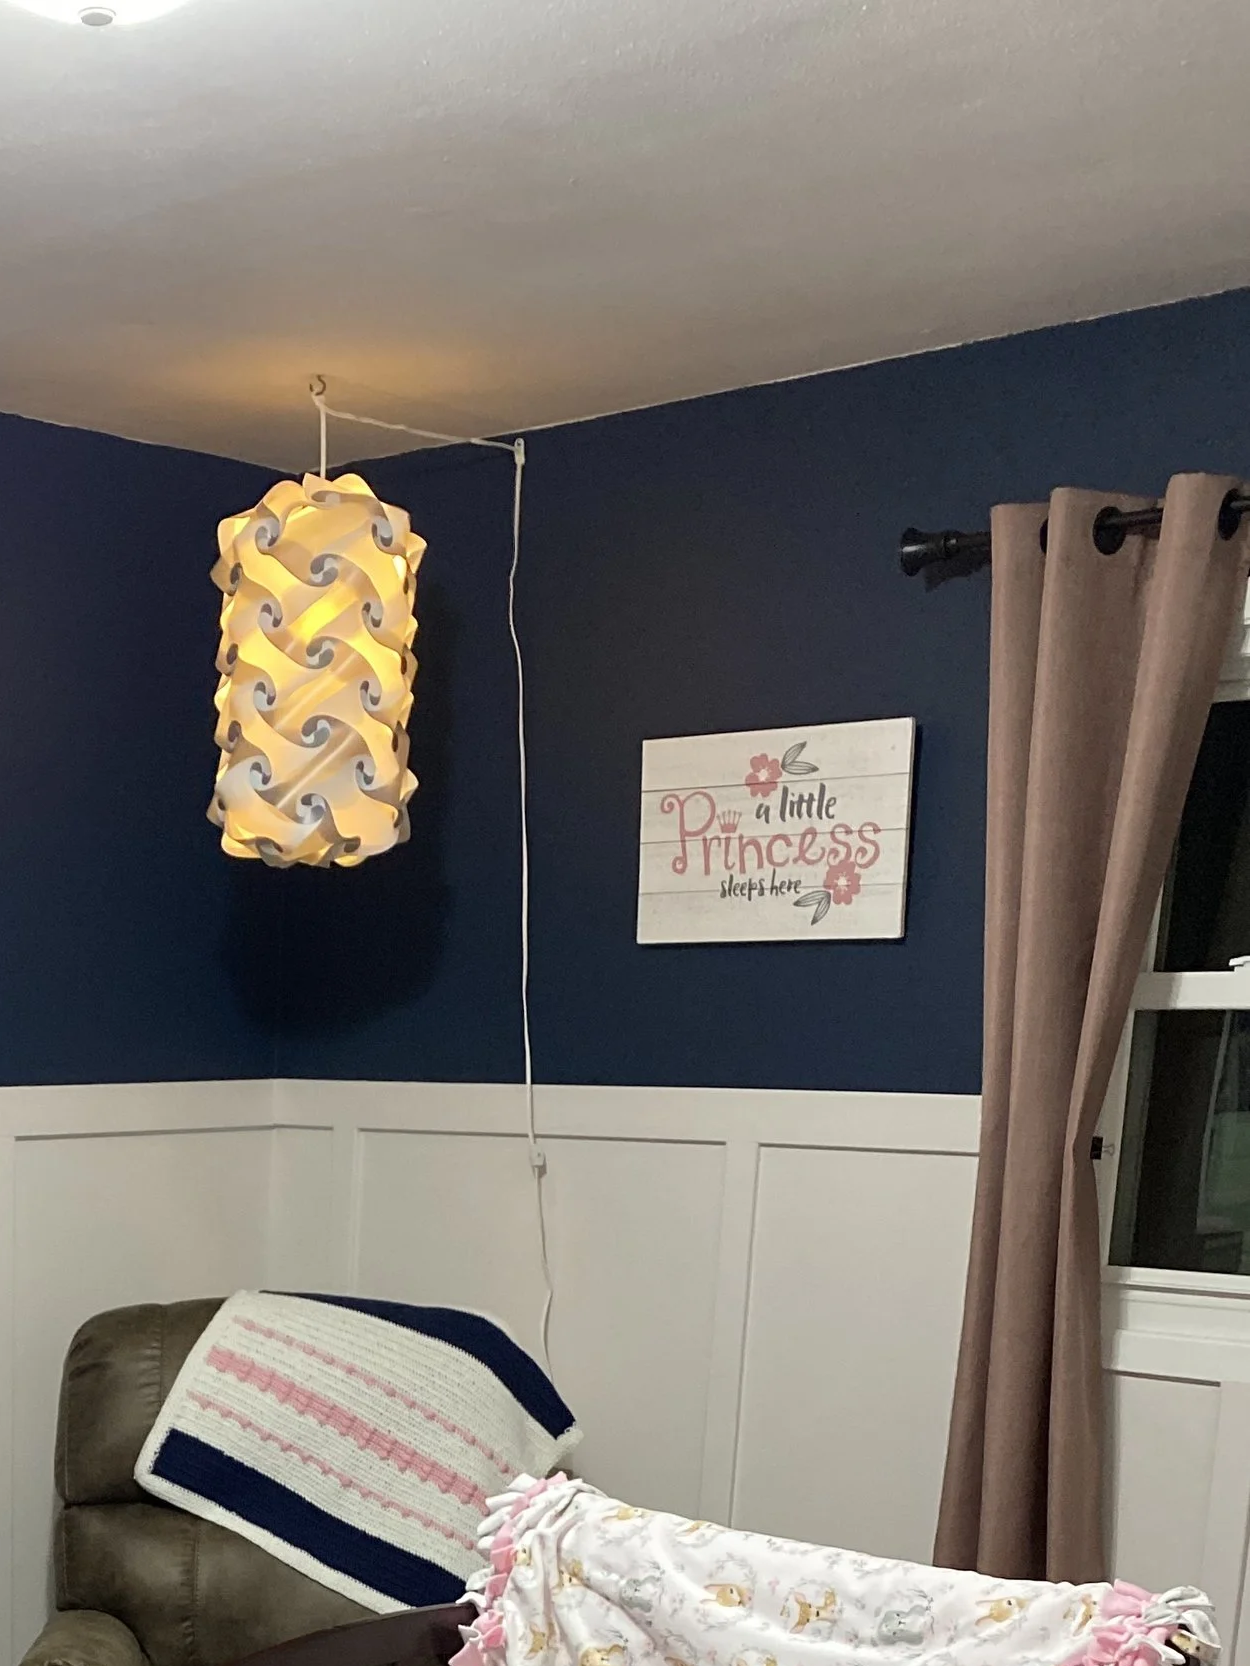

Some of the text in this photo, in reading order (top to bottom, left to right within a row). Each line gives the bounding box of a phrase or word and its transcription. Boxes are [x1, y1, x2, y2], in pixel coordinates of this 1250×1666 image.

[755, 782, 836, 824] a little
[660, 790, 882, 876] Princess
[720, 868, 801, 901] sleeps here
